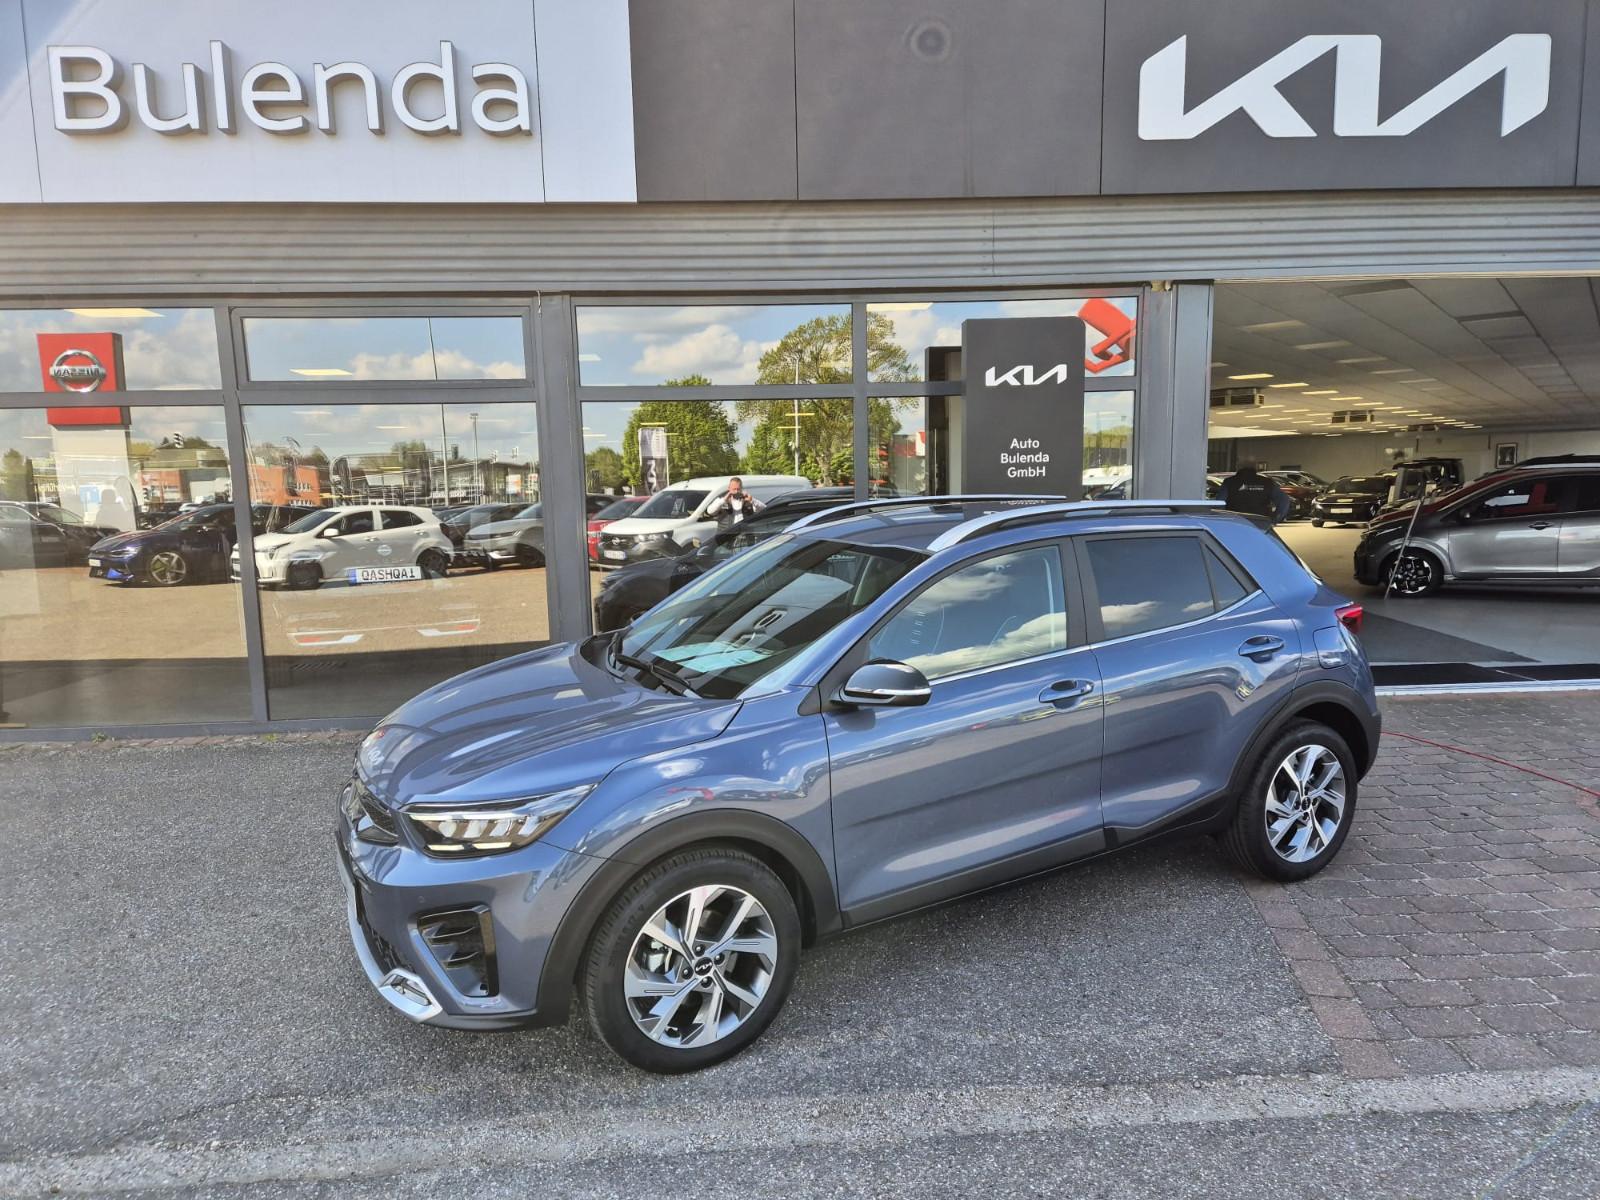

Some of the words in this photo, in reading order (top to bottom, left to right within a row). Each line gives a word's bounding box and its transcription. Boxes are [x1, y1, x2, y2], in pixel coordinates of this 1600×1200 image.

[47, 40, 532, 135] Bulenda
[1138, 34, 1552, 140] KIA
[985, 364, 1067, 387] KIA
[1010, 438, 1040, 449] Auto
[1000, 452, 1050, 464] Bulenda
[1007, 466, 1046, 478] GmbH
[361, 567, 415, 581] QASHQAI
